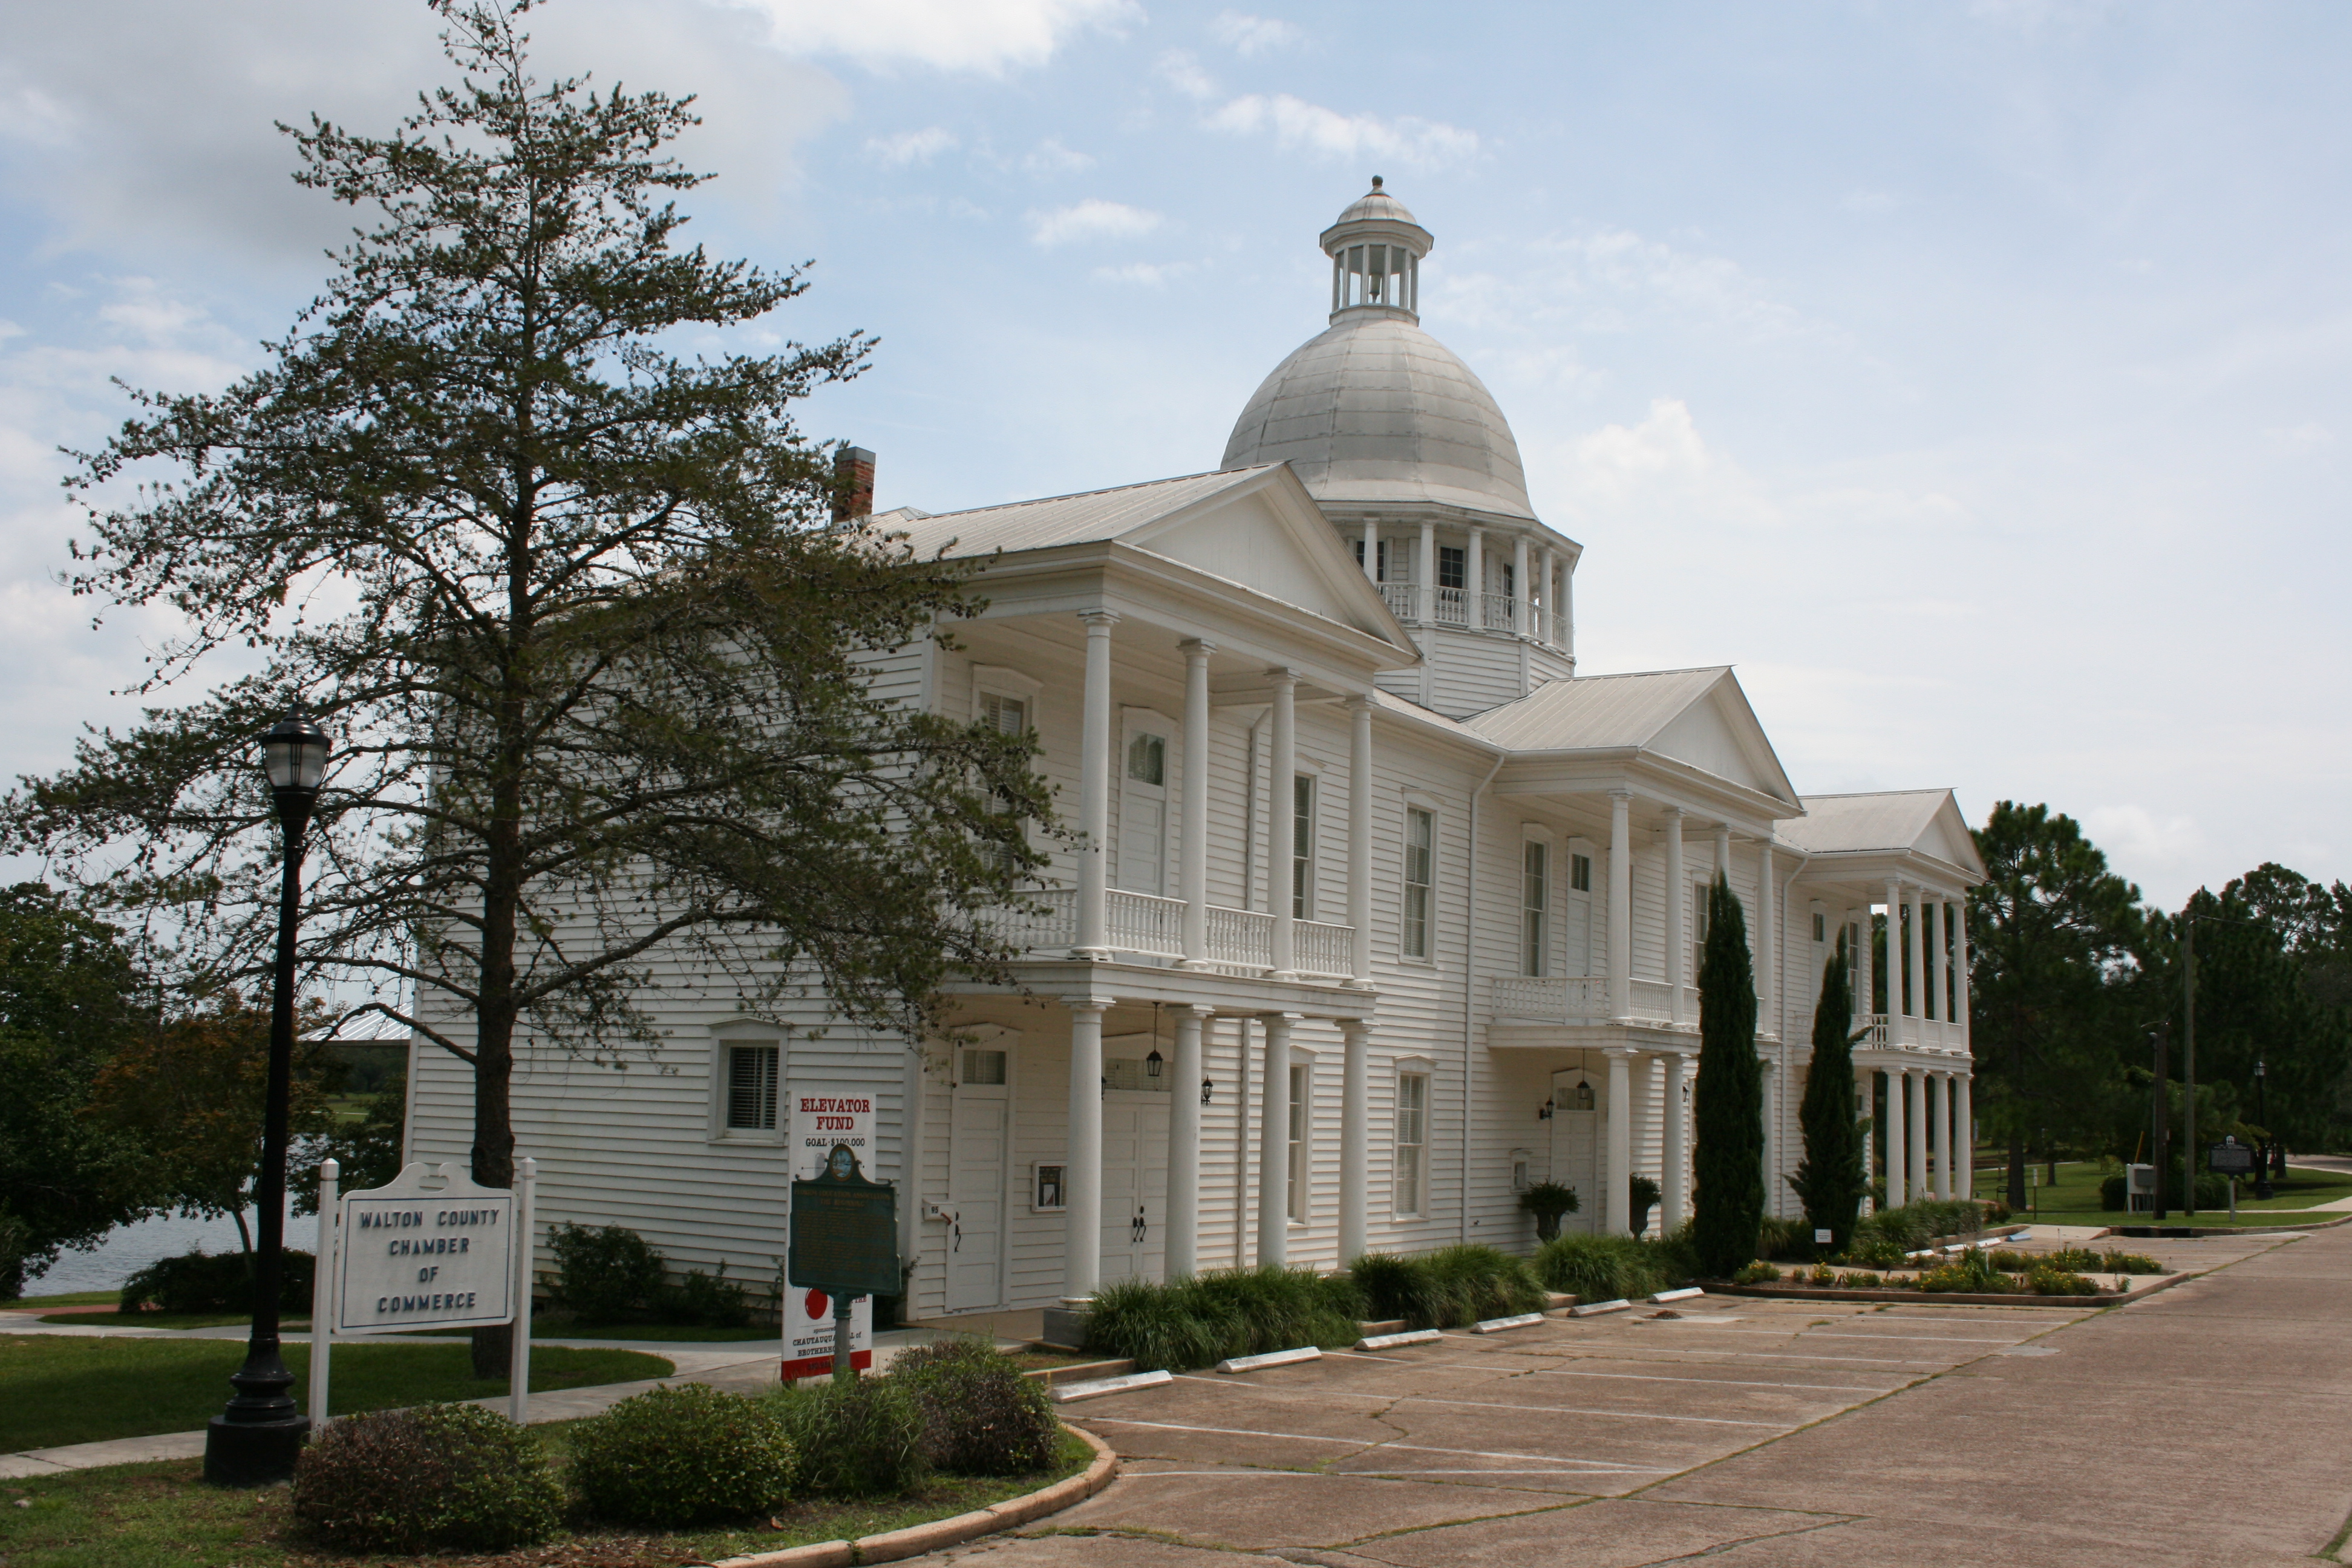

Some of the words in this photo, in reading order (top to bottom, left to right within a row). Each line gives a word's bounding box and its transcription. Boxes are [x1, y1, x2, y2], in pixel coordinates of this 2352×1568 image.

[800, 1098, 870, 1112] ELEVATOR
[816, 1116, 854, 1130] FUND
[361, 1211, 423, 1227] WALTON
[438, 1209, 500, 1226] COUNTY
[390, 1238, 470, 1255] CHAMBER
[419, 1266, 439, 1282] OF
[378, 1292, 476, 1313] COMMERCE
